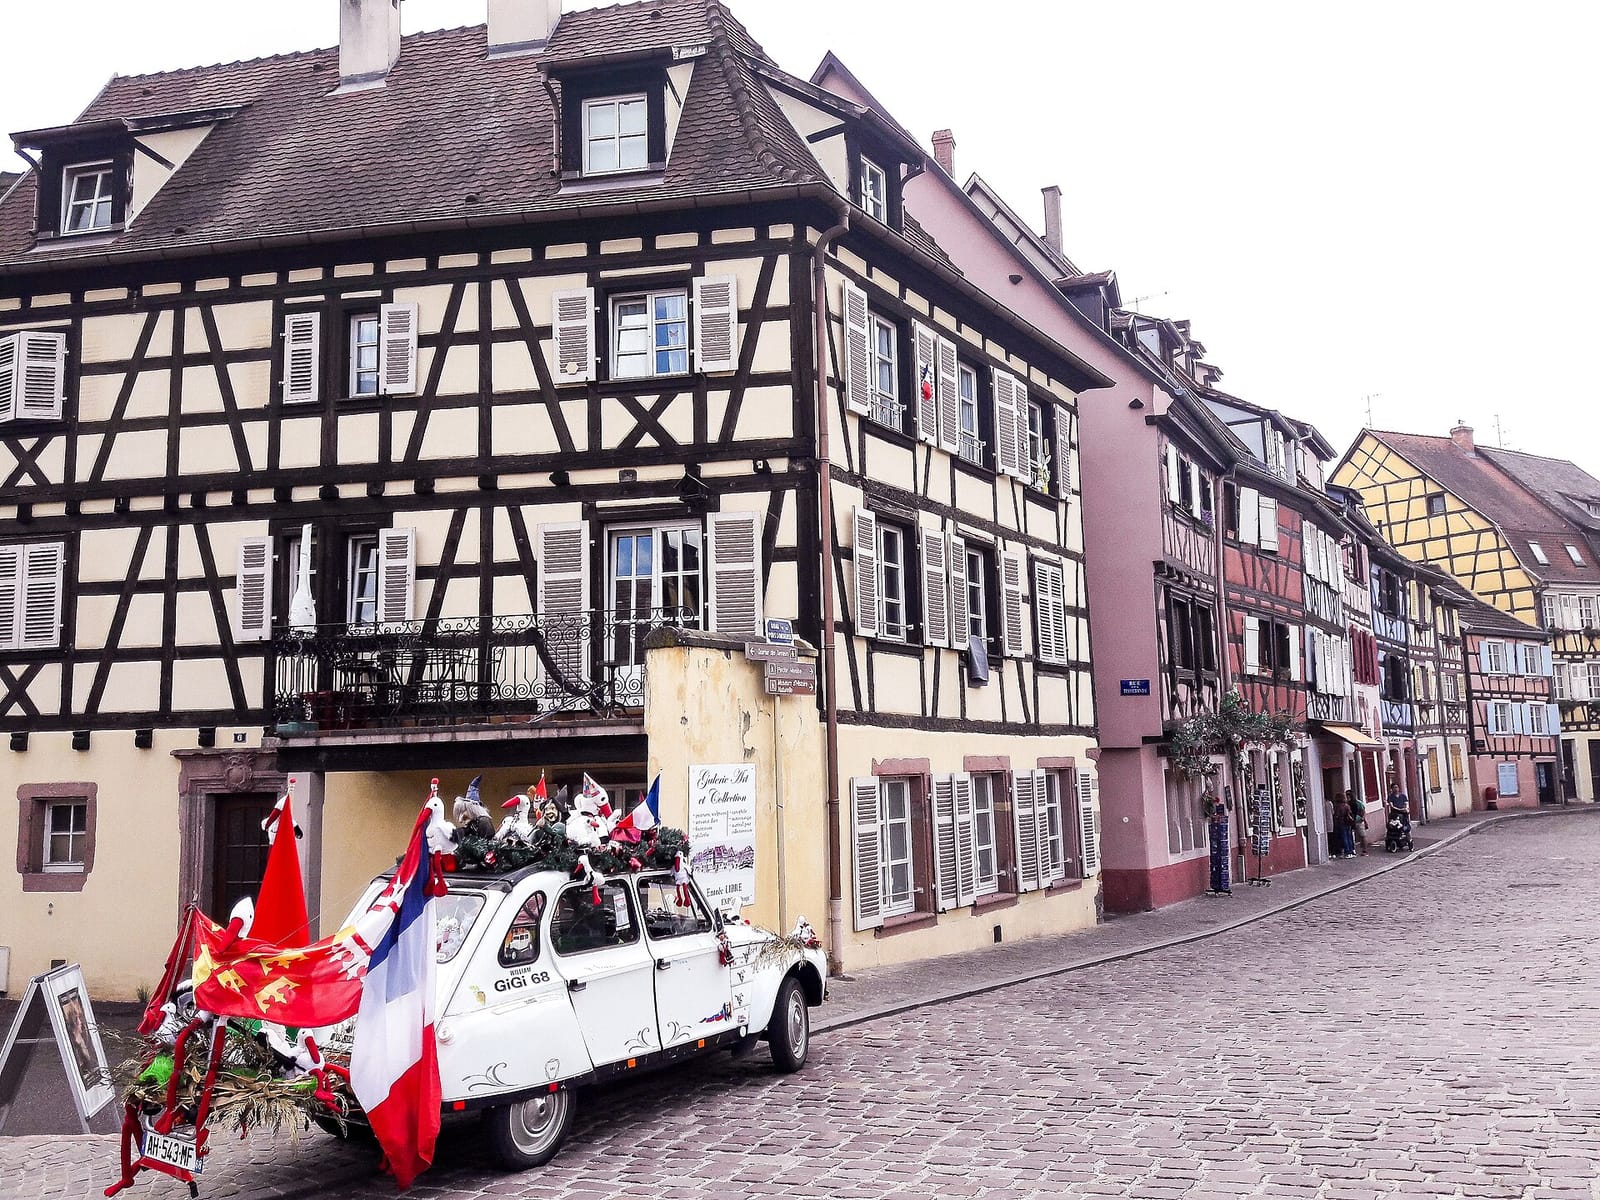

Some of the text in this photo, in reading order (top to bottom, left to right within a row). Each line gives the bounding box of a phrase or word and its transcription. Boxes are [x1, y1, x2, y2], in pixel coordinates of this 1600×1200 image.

[730, 768, 749, 785] Art
[698, 788, 747, 805] et Collection
[724, 882, 743, 894] LIBRE
[494, 971, 550, 992] GiGi 68
[146, 1135, 195, 1167] AH-543-MF
